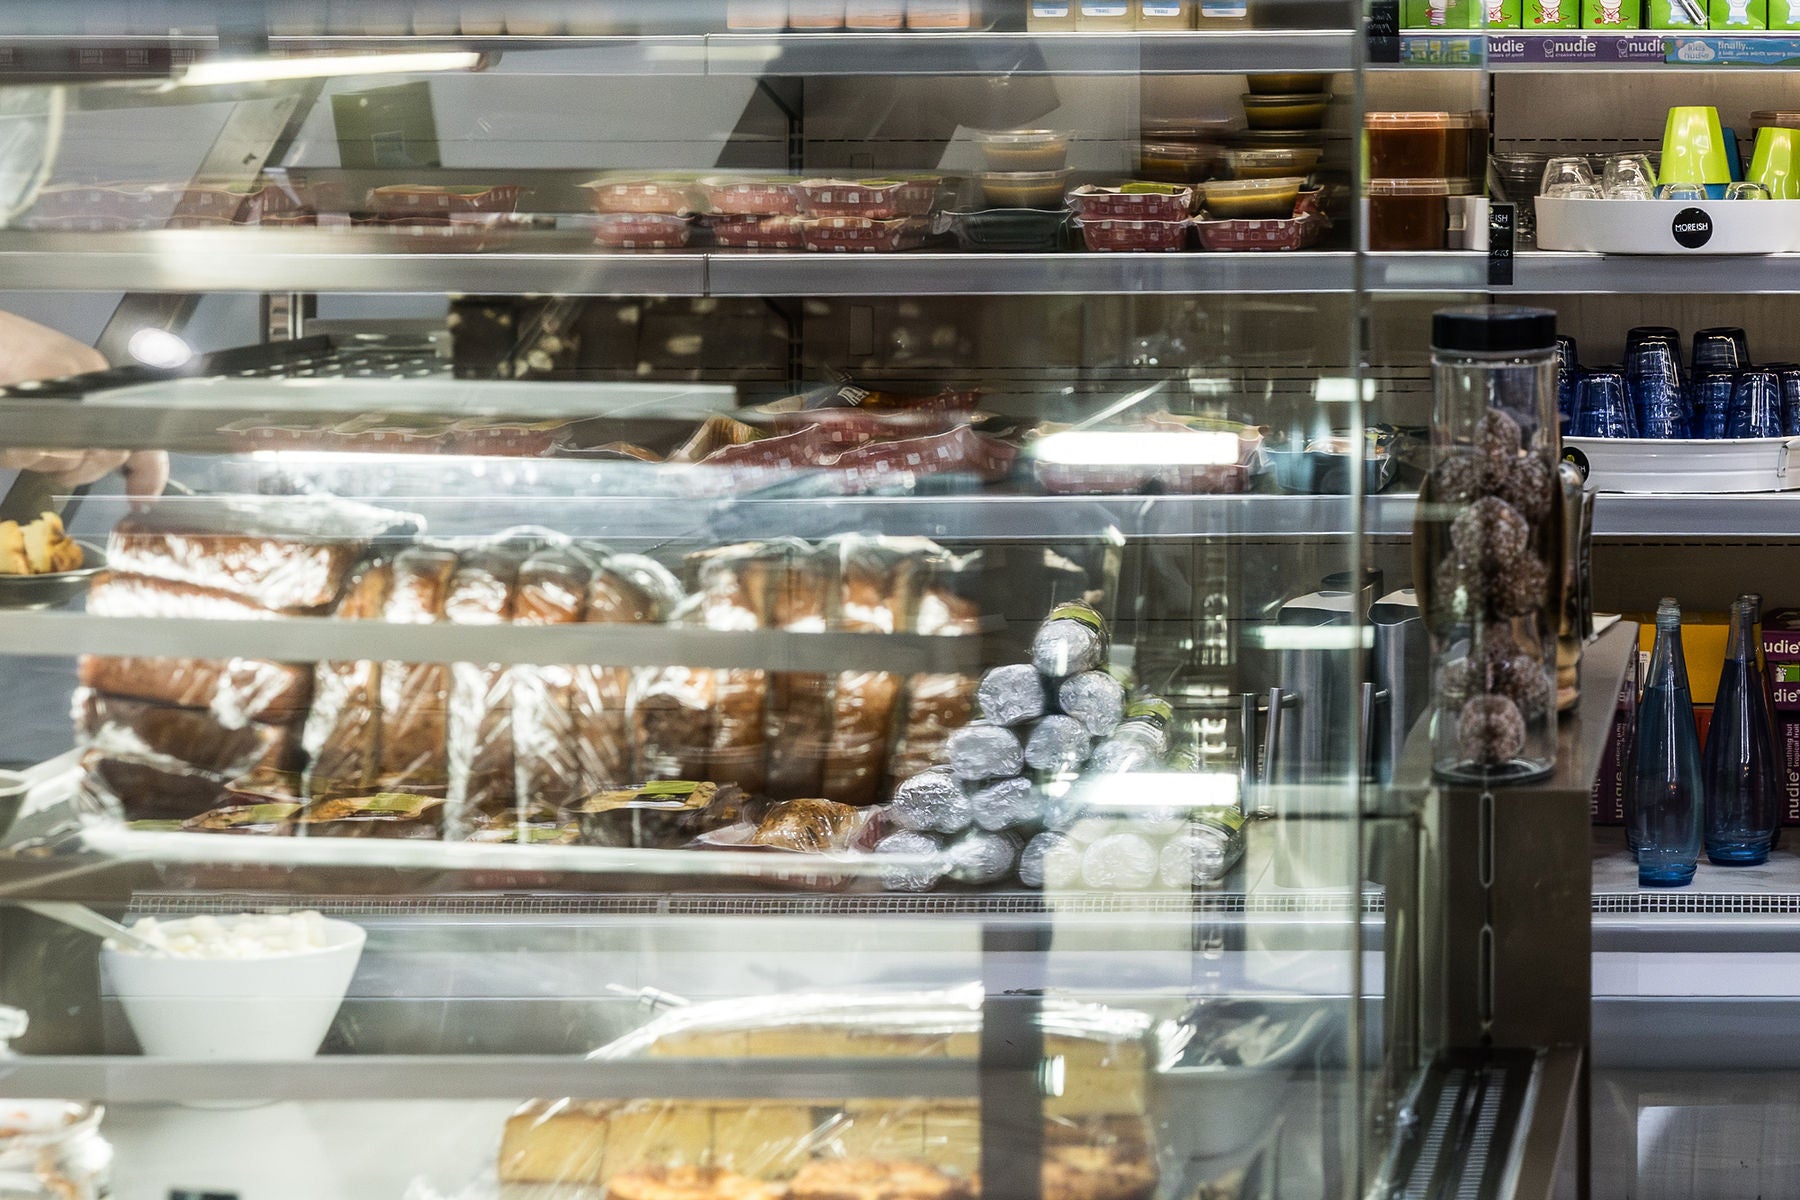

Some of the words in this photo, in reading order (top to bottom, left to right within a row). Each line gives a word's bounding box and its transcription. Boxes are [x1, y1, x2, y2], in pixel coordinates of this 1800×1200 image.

[1555, 40, 1598, 52] nudie
[1675, 222, 1709, 232] MOREISH
[1786, 772, 1800, 819] nudie
